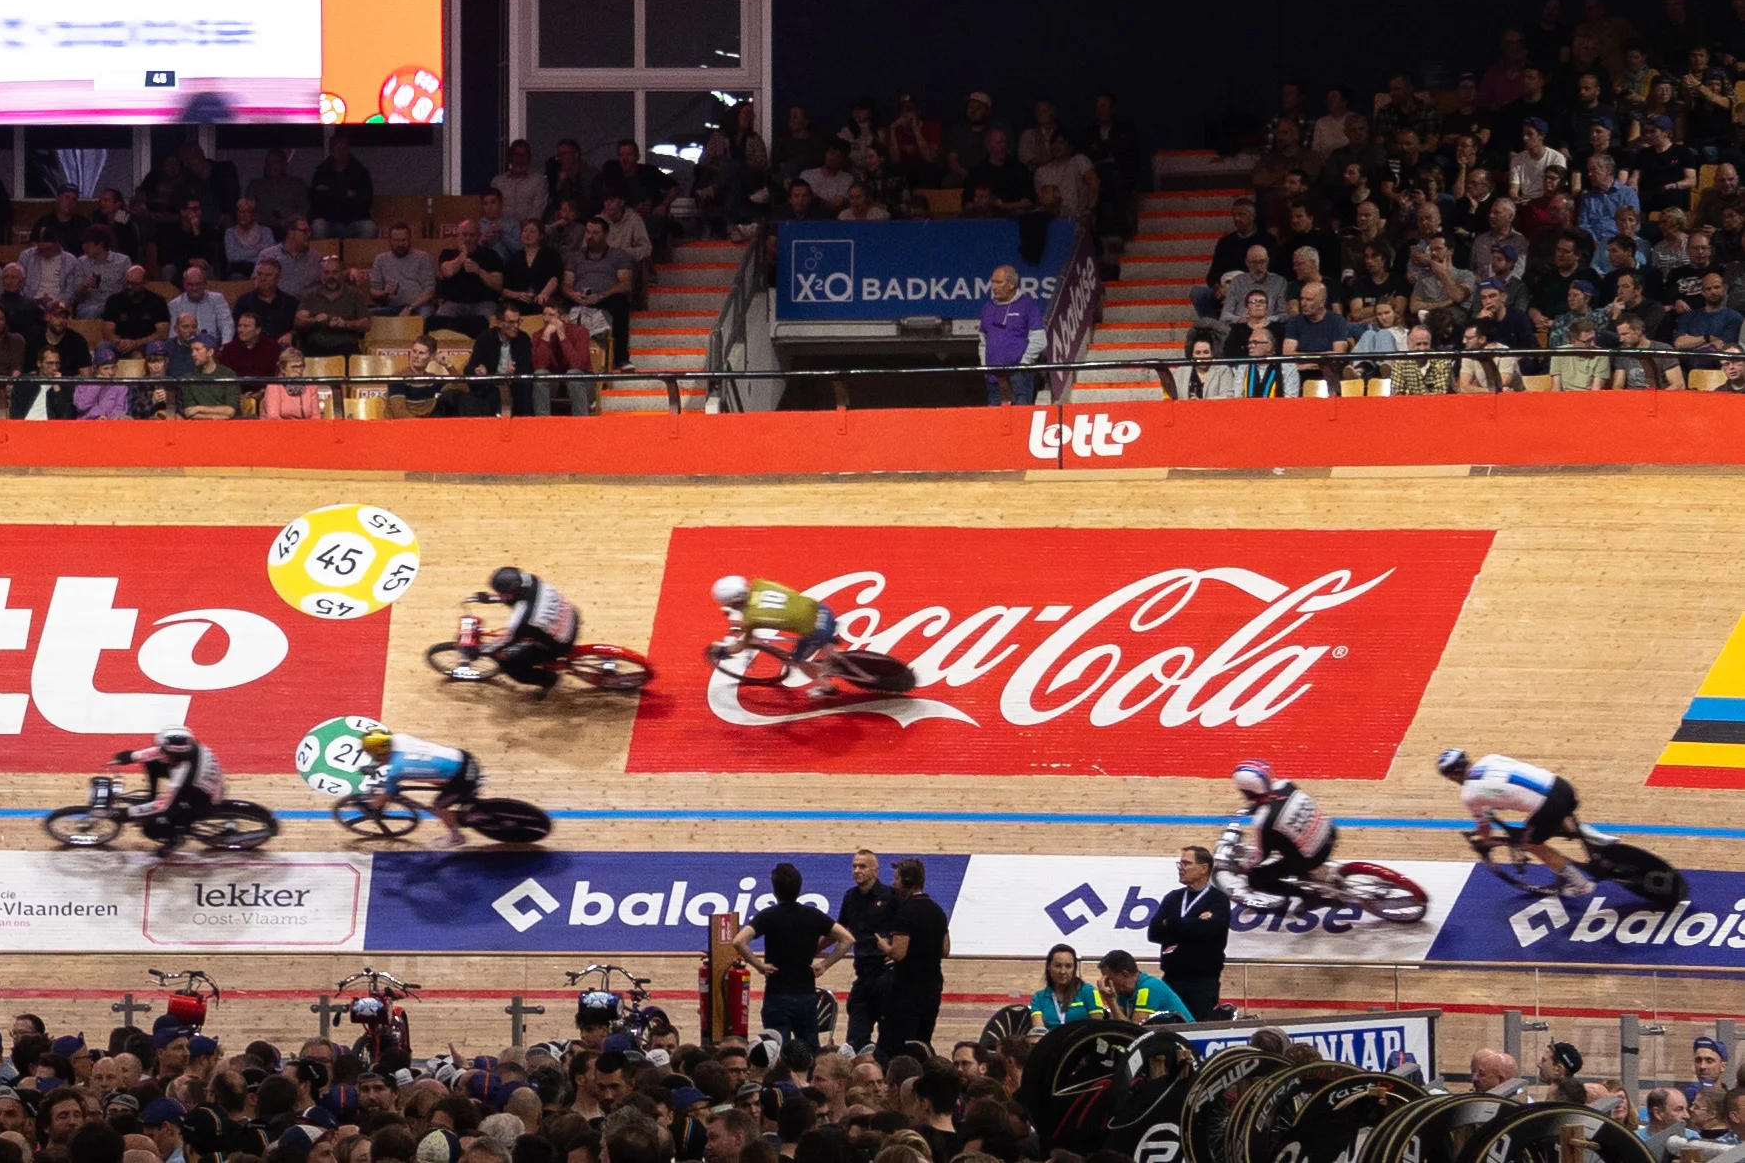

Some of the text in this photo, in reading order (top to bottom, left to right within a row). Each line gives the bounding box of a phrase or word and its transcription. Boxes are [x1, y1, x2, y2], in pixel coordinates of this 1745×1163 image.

[861, 277, 1057, 302] BADKAMRS
[1057, 253, 1096, 359] baloise
[1029, 411, 1142, 460] lotto
[368, 513, 402, 536] 45
[278, 524, 300, 560] 45
[315, 542, 364, 576] 45
[382, 563, 416, 592] 45
[315, 598, 355, 617] 45
[707, 567, 1397, 729] Coca-Cola
[333, 743, 365, 766] 21
[317, 778, 342, 794] 21
[194, 882, 310, 909] lekker
[192, 912, 308, 926] Oost-Vlaams
